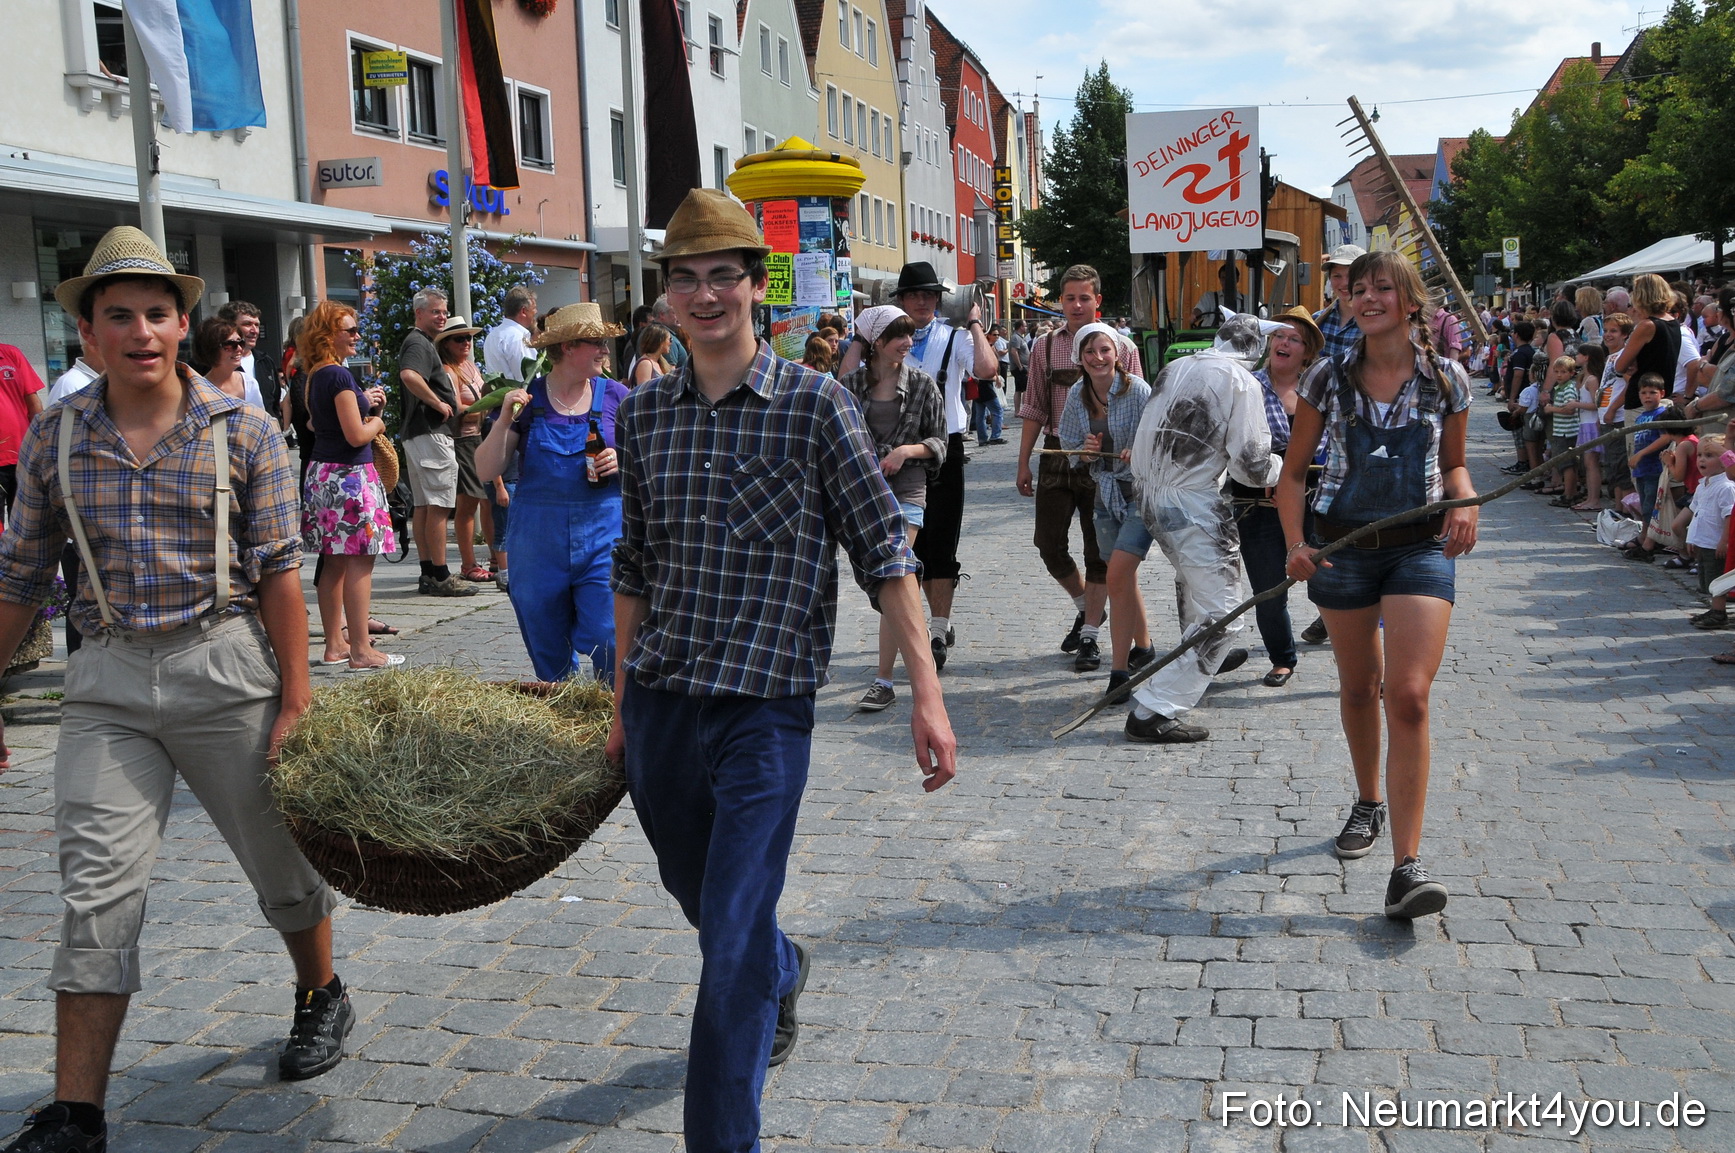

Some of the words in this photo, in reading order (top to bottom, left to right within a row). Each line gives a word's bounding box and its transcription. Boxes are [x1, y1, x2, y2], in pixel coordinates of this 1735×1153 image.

[1133, 111, 1242, 177] DEININGER
[995, 168, 1013, 258] HOTEL
[1131, 210, 1260, 243] LANDJUGEND
[167, 249, 189, 265] echt
[772, 254, 790, 264] Club
[768, 271, 789, 279] est
[767, 280, 789, 289] rty"
